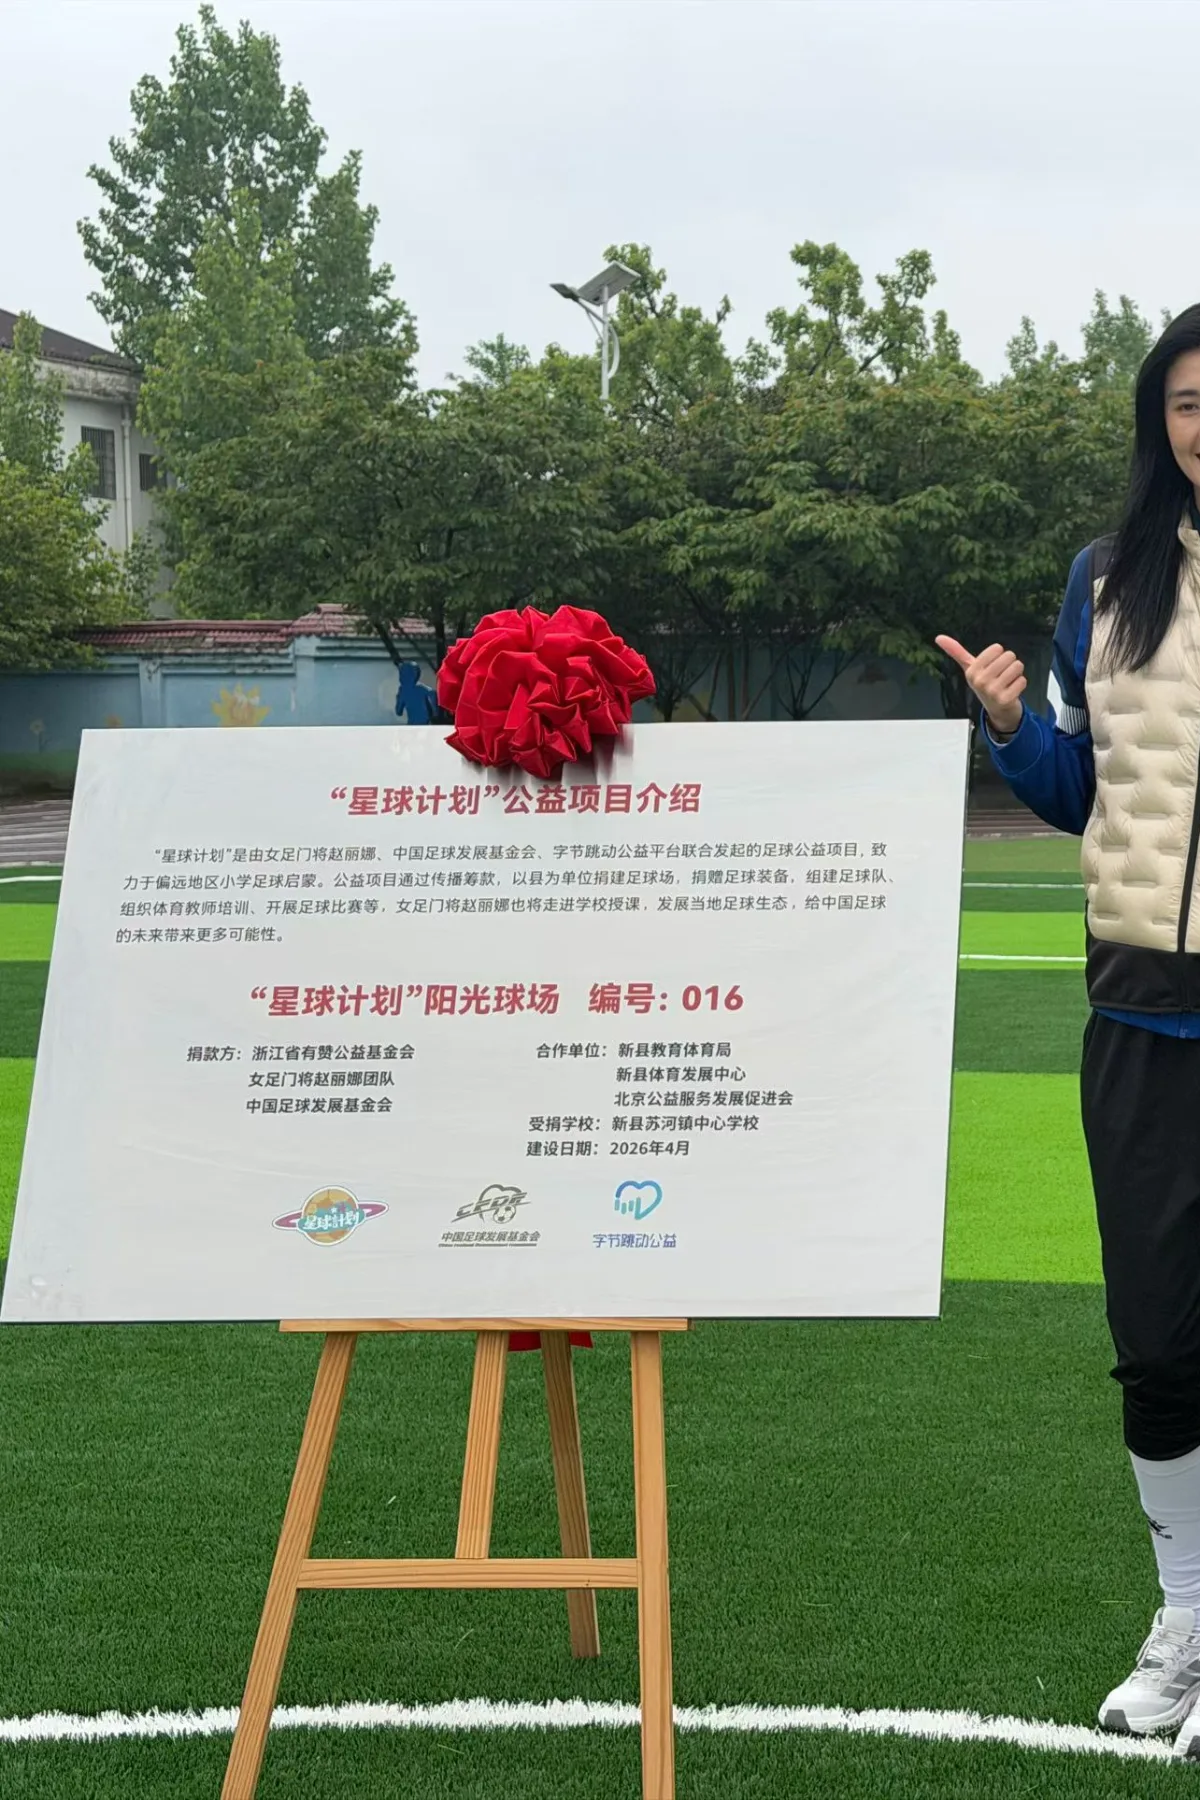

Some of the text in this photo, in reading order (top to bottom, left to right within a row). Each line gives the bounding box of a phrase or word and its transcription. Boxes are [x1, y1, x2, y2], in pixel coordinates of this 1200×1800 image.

[330, 783, 702, 817] “星球计划”公益项目介绍
[115, 926, 284, 944] 的未来带来更多可能性。
[250, 982, 560, 1017] “星球计划”阳光球场
[247, 1070, 395, 1088] 女足门将赵丽娜团队
[615, 1066, 747, 1082] 新县体育发展中心
[245, 1096, 393, 1114] 中国足球发展基金会
[613, 1090, 794, 1107] 北京公益服务发展促进会
[441, 1230, 541, 1242] 中国足球发展基金会
[593, 1233, 677, 1249] 字节跳动公益
